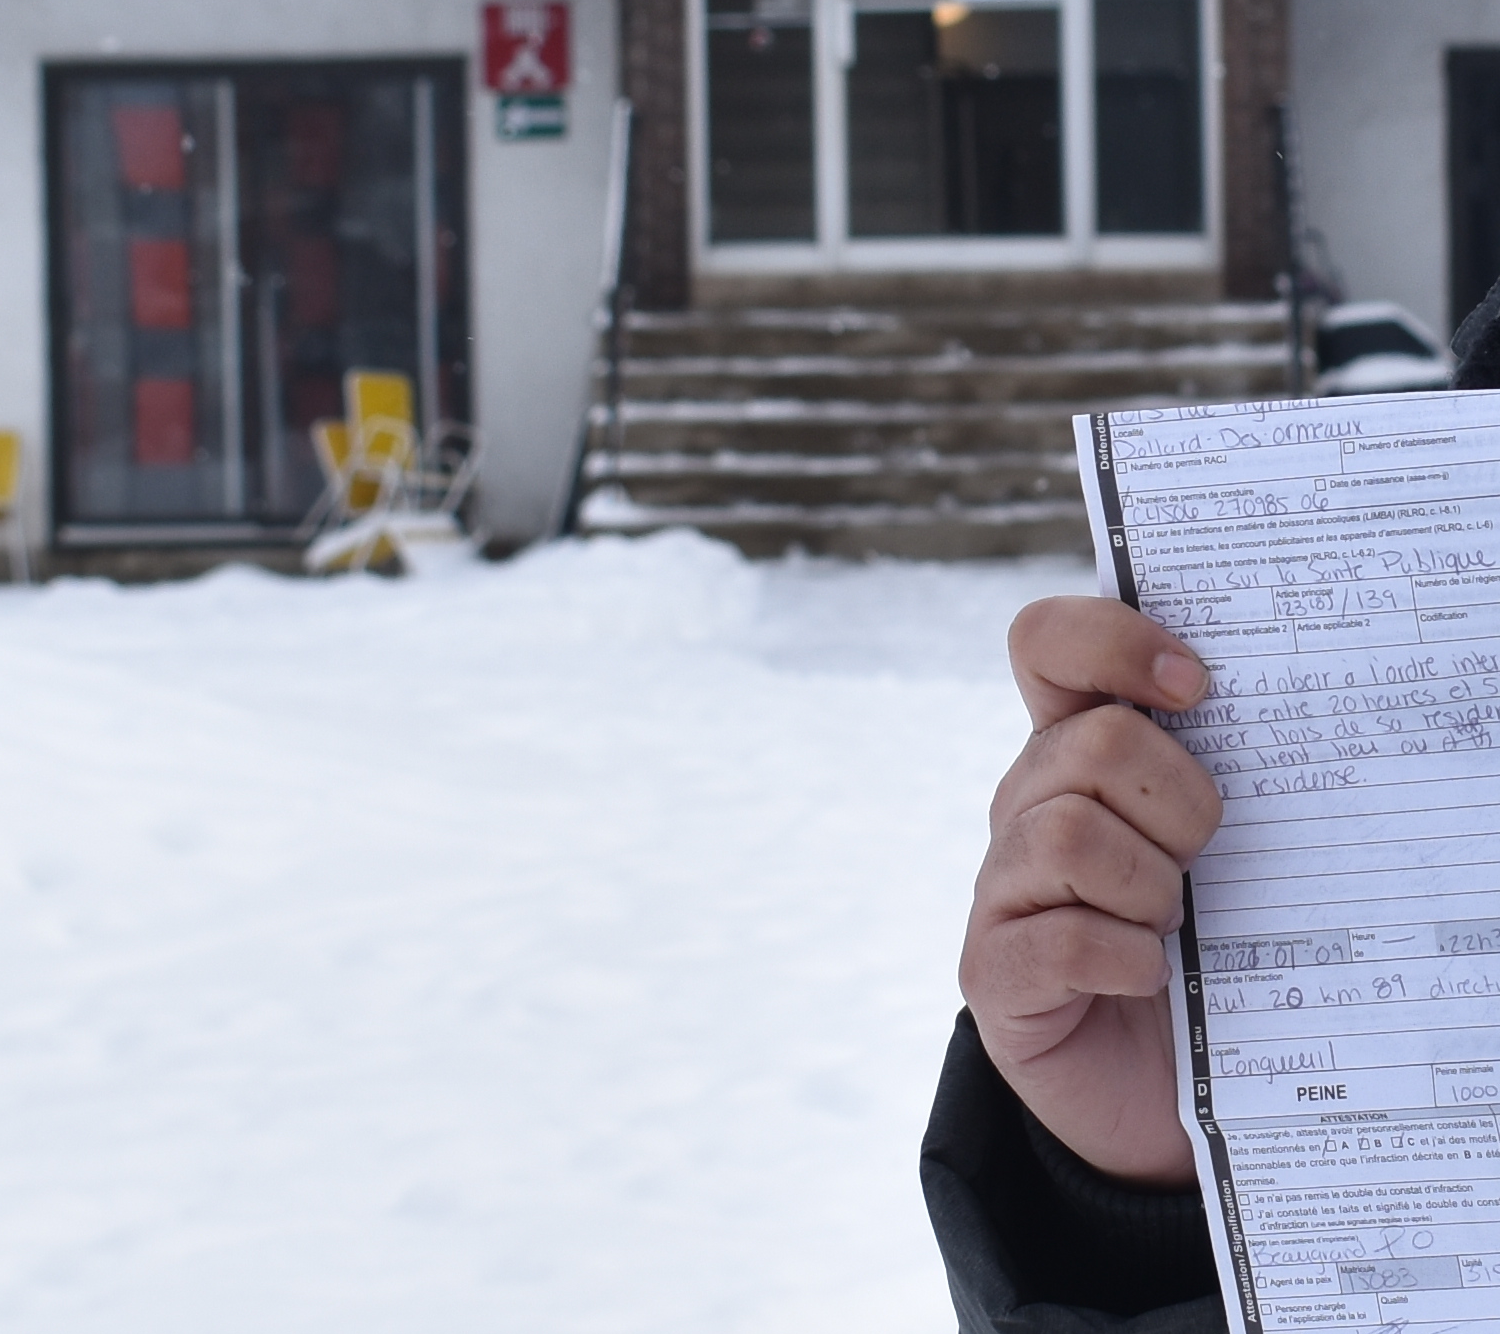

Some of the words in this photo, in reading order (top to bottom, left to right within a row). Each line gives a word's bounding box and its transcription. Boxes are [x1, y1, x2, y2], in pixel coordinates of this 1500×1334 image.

[1112, 535, 1125, 549] B
[1188, 981, 1199, 995] C
[1318, 985, 1363, 1004] km
[1371, 973, 1407, 1001] 89
[1193, 1025, 1204, 1053] Lieu
[1195, 1083, 1210, 1097] D
[1296, 1083, 1348, 1104] PEINE
[1451, 1084, 1499, 1104] 1000
